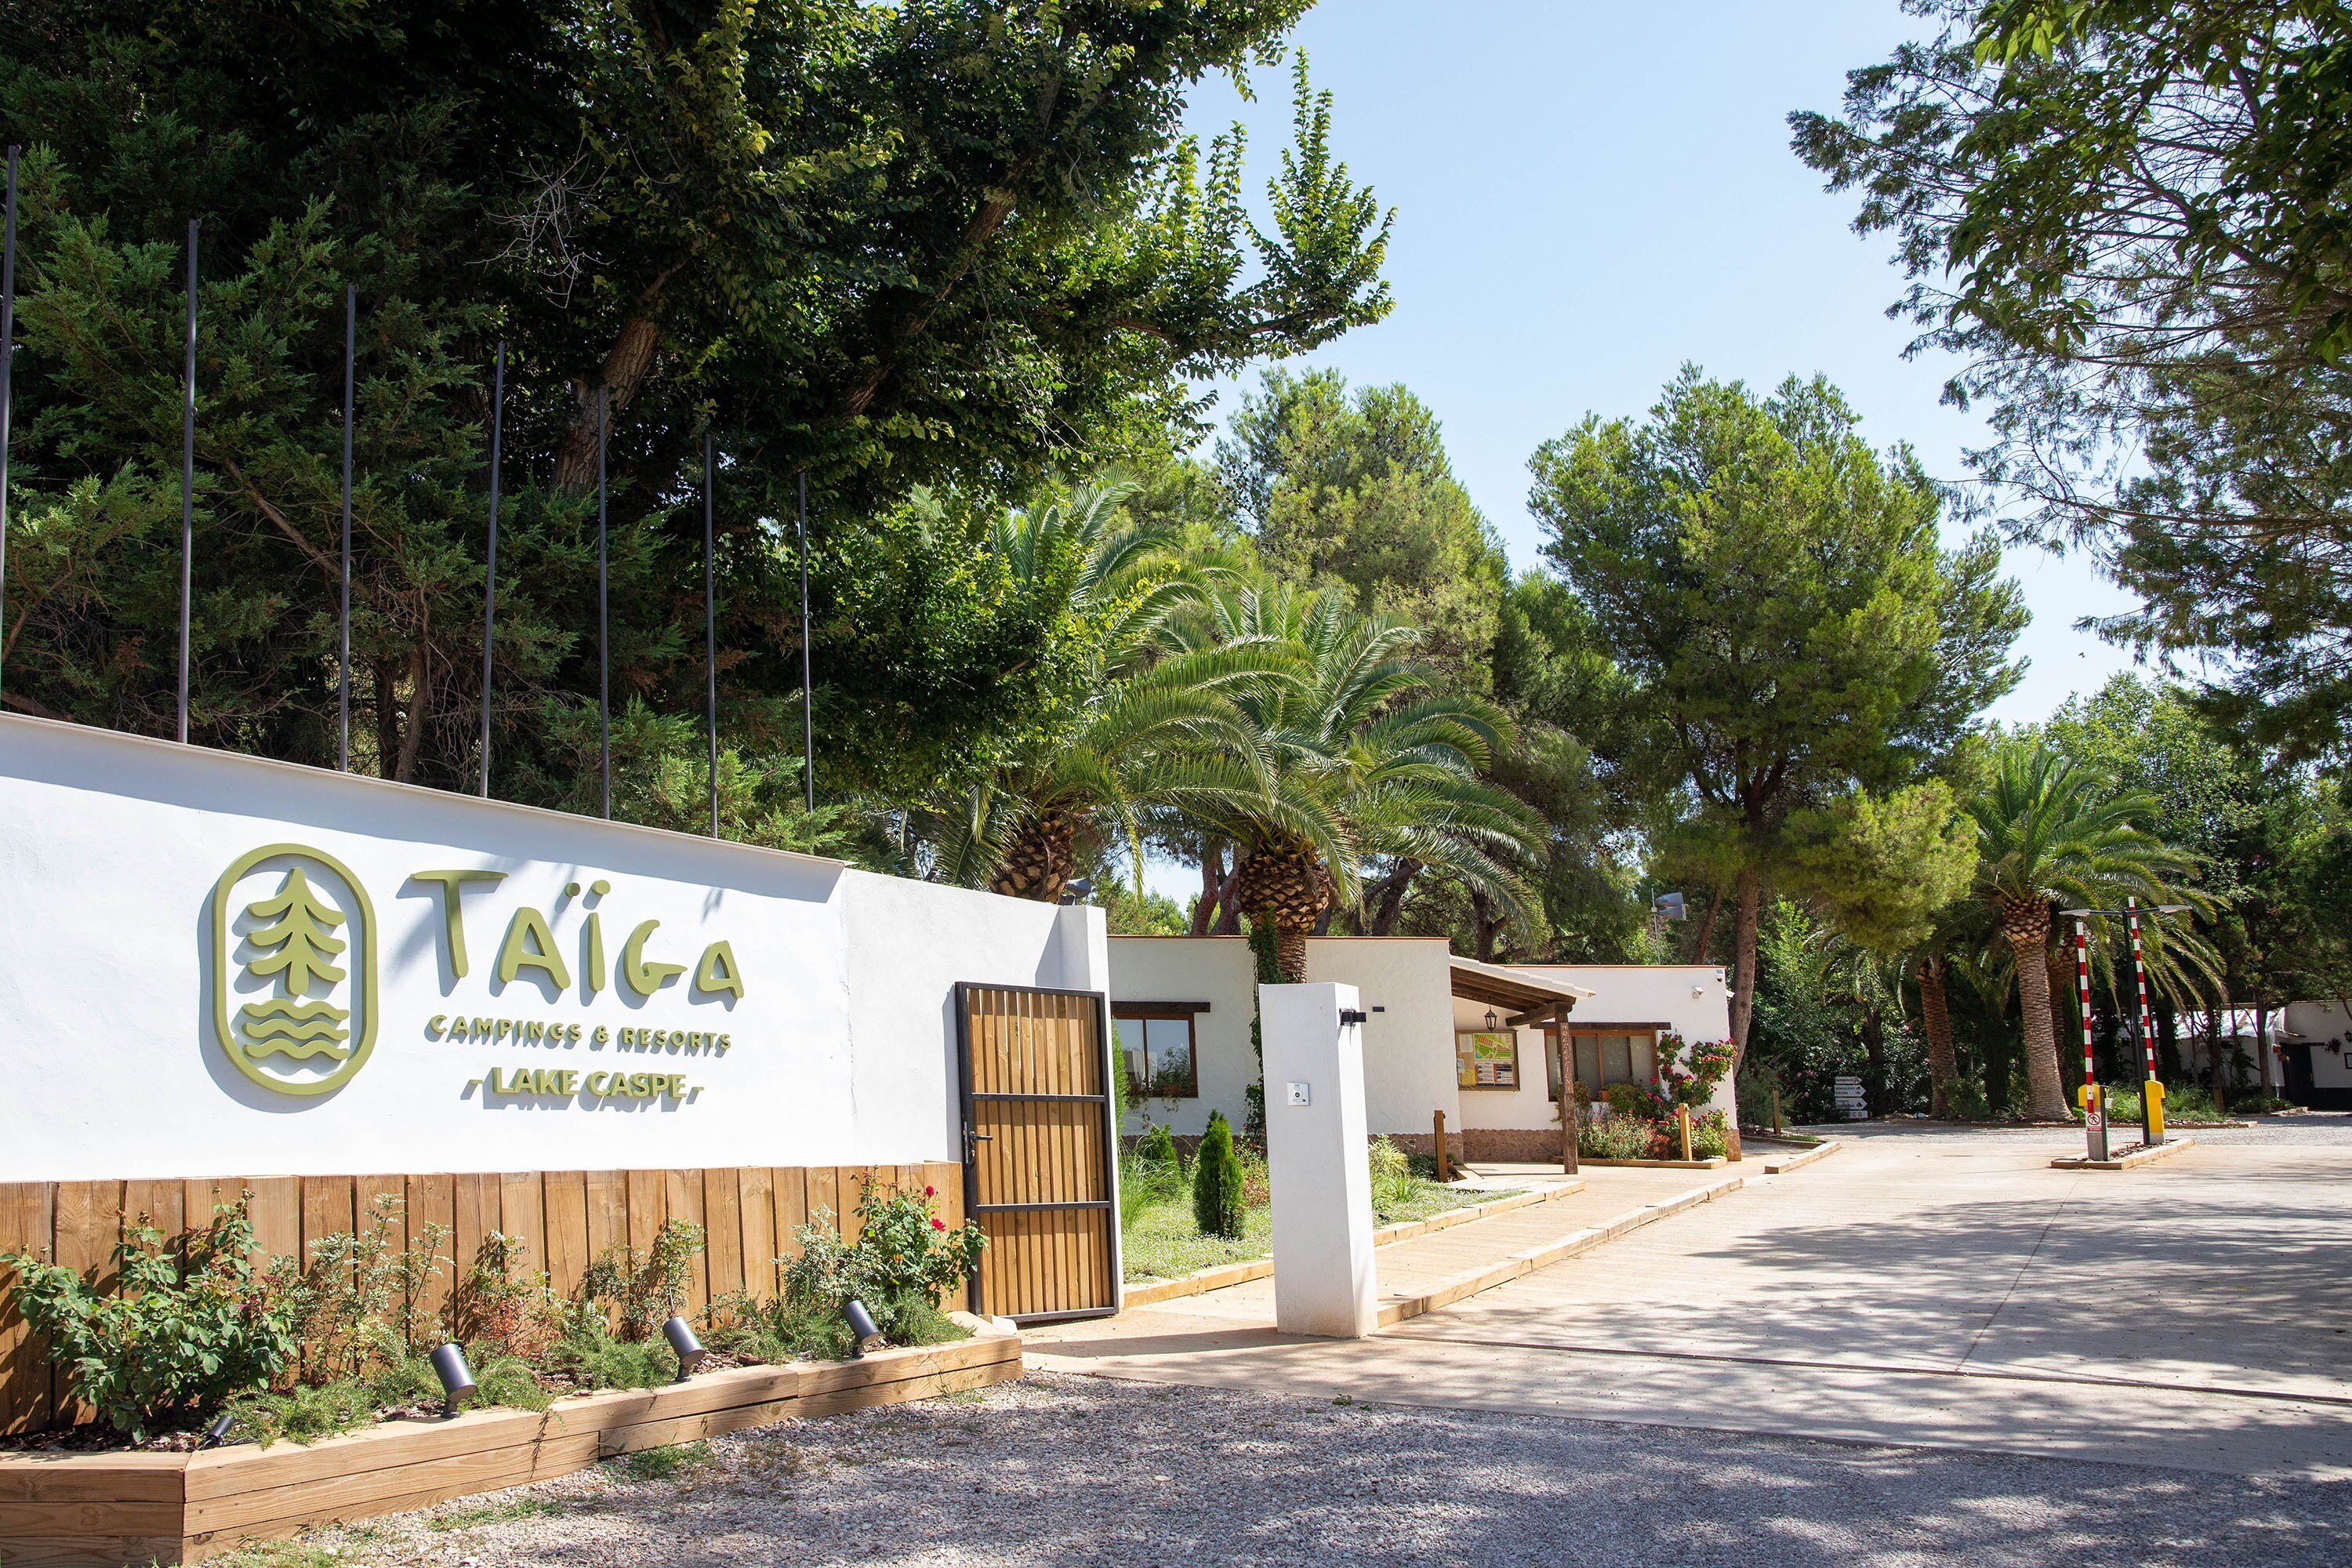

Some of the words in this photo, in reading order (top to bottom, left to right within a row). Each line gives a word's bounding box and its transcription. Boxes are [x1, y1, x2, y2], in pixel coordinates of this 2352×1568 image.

[430, 1015, 582, 1041] CAMPINGS
[594, 1025, 610, 1044] &
[622, 1028, 731, 1050] RESORTS
